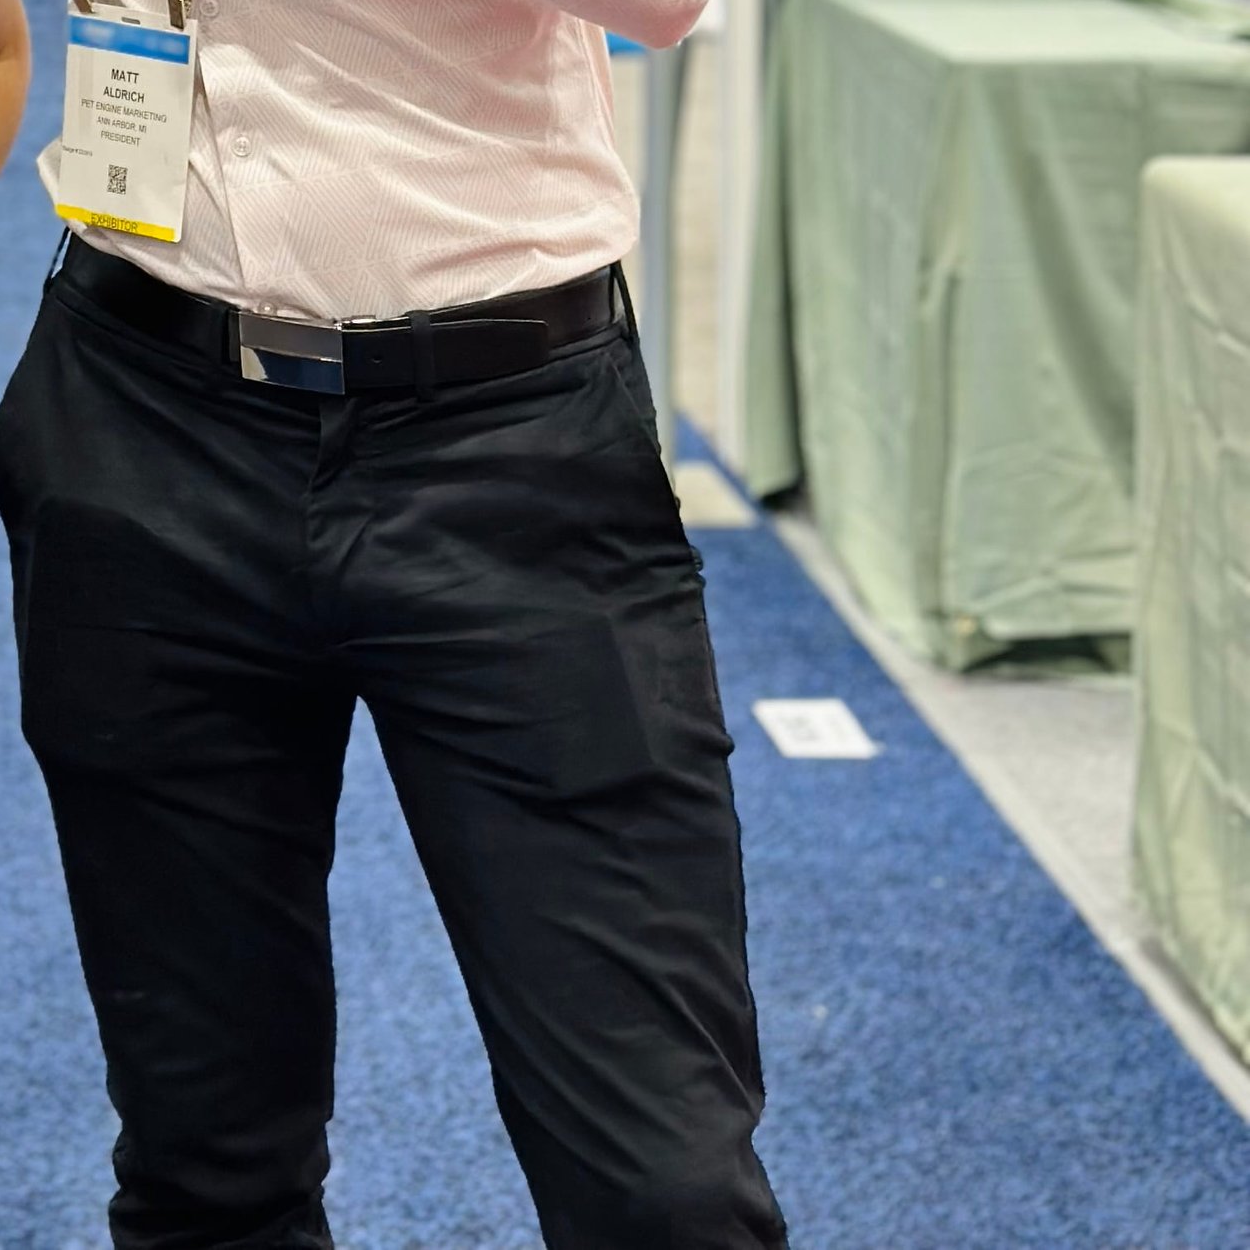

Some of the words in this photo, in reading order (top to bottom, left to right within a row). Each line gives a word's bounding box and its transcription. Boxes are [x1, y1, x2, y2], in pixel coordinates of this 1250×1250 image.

[110, 68, 140, 84] MATT
[103, 86, 145, 104] ALDRICH
[81, 98, 95, 109] PET
[95, 101, 122, 115] ENGINE
[123, 106, 168, 123] MARKETING
[97, 116, 111, 126] ANN
[100, 130, 141, 147] PRESIDENT
[91, 213, 138, 232] EXHIBITOR
